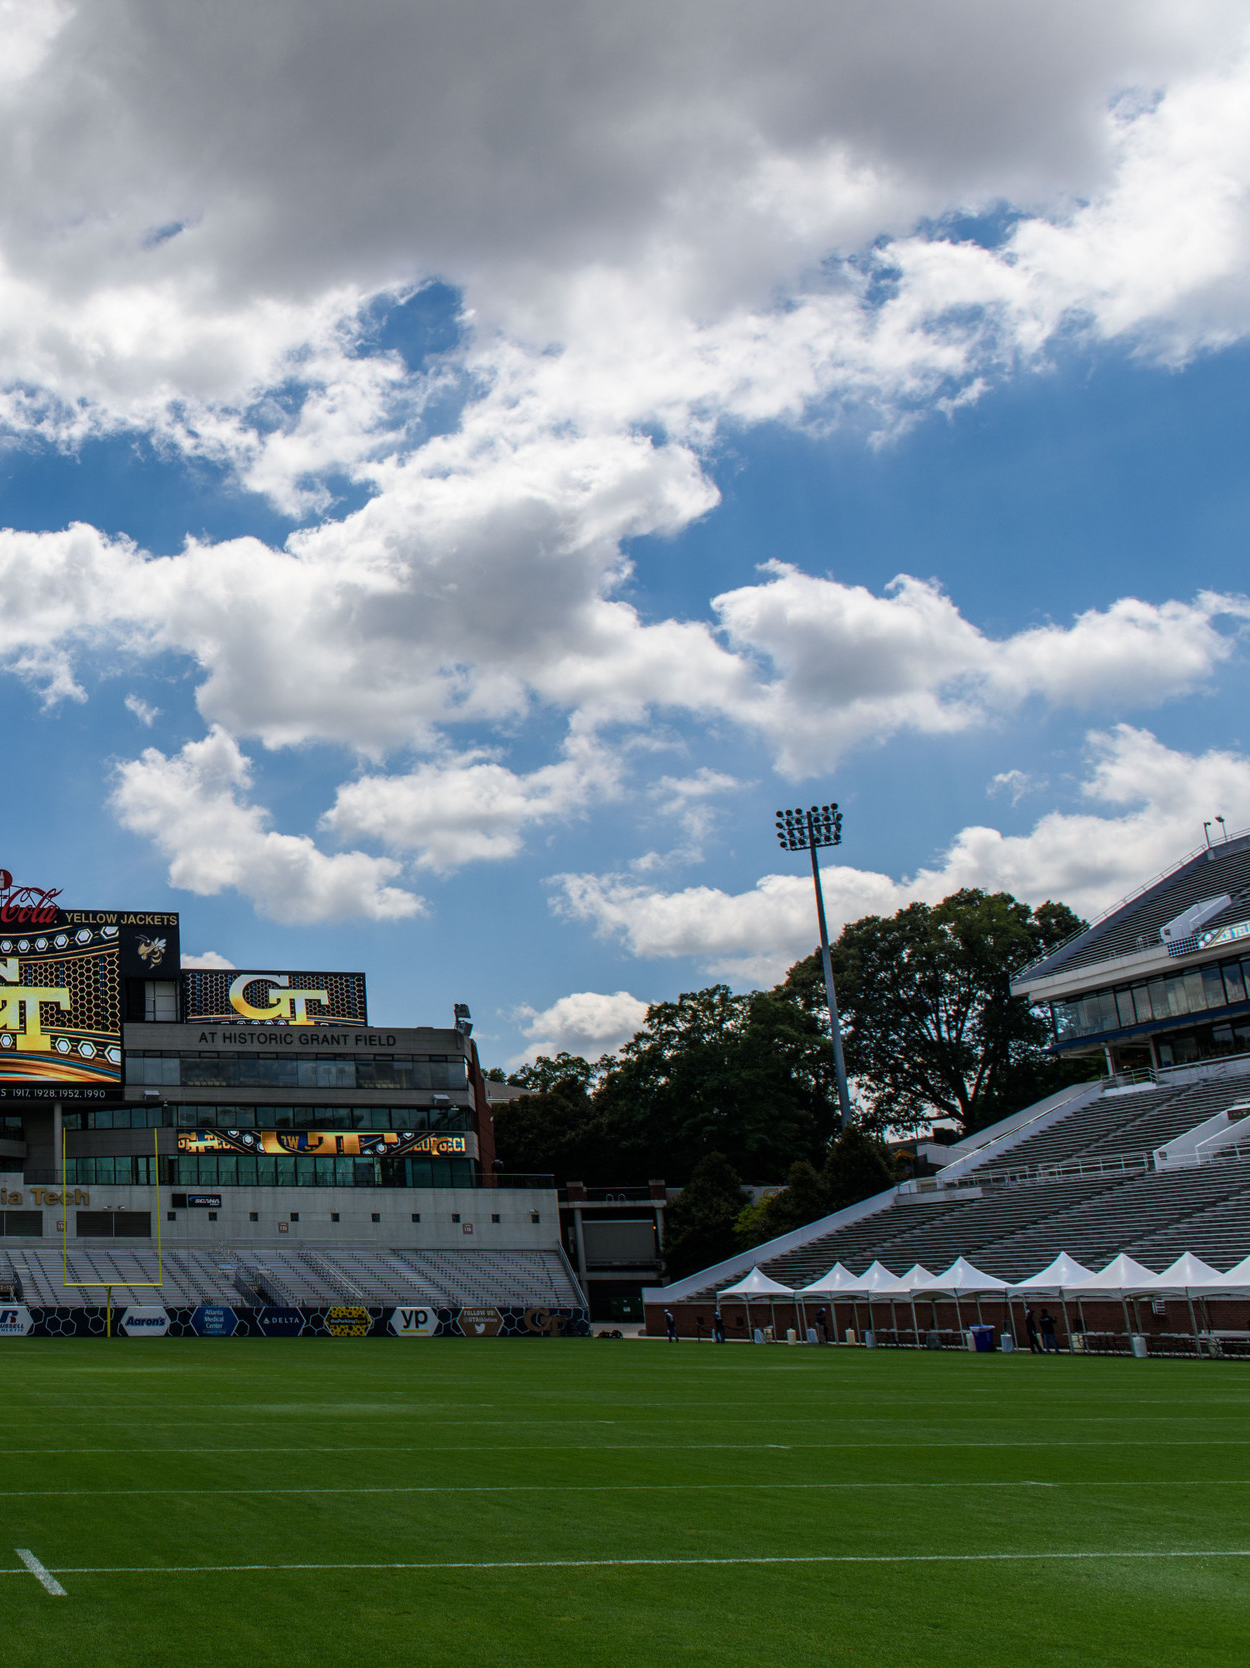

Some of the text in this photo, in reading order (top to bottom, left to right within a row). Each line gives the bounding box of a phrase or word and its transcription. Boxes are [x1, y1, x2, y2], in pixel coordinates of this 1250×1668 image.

[65, 913, 178, 925] YELLOW JACKETS
[228, 974, 329, 1026] GT
[198, 1032, 397, 1046] AT HISTORIC GRANT FIELD
[84, 1089, 106, 1098] 1990
[30, 1187, 89, 1206] Tech
[125, 1316, 166, 1326] Aaron's
[401, 1310, 429, 1328] yp
